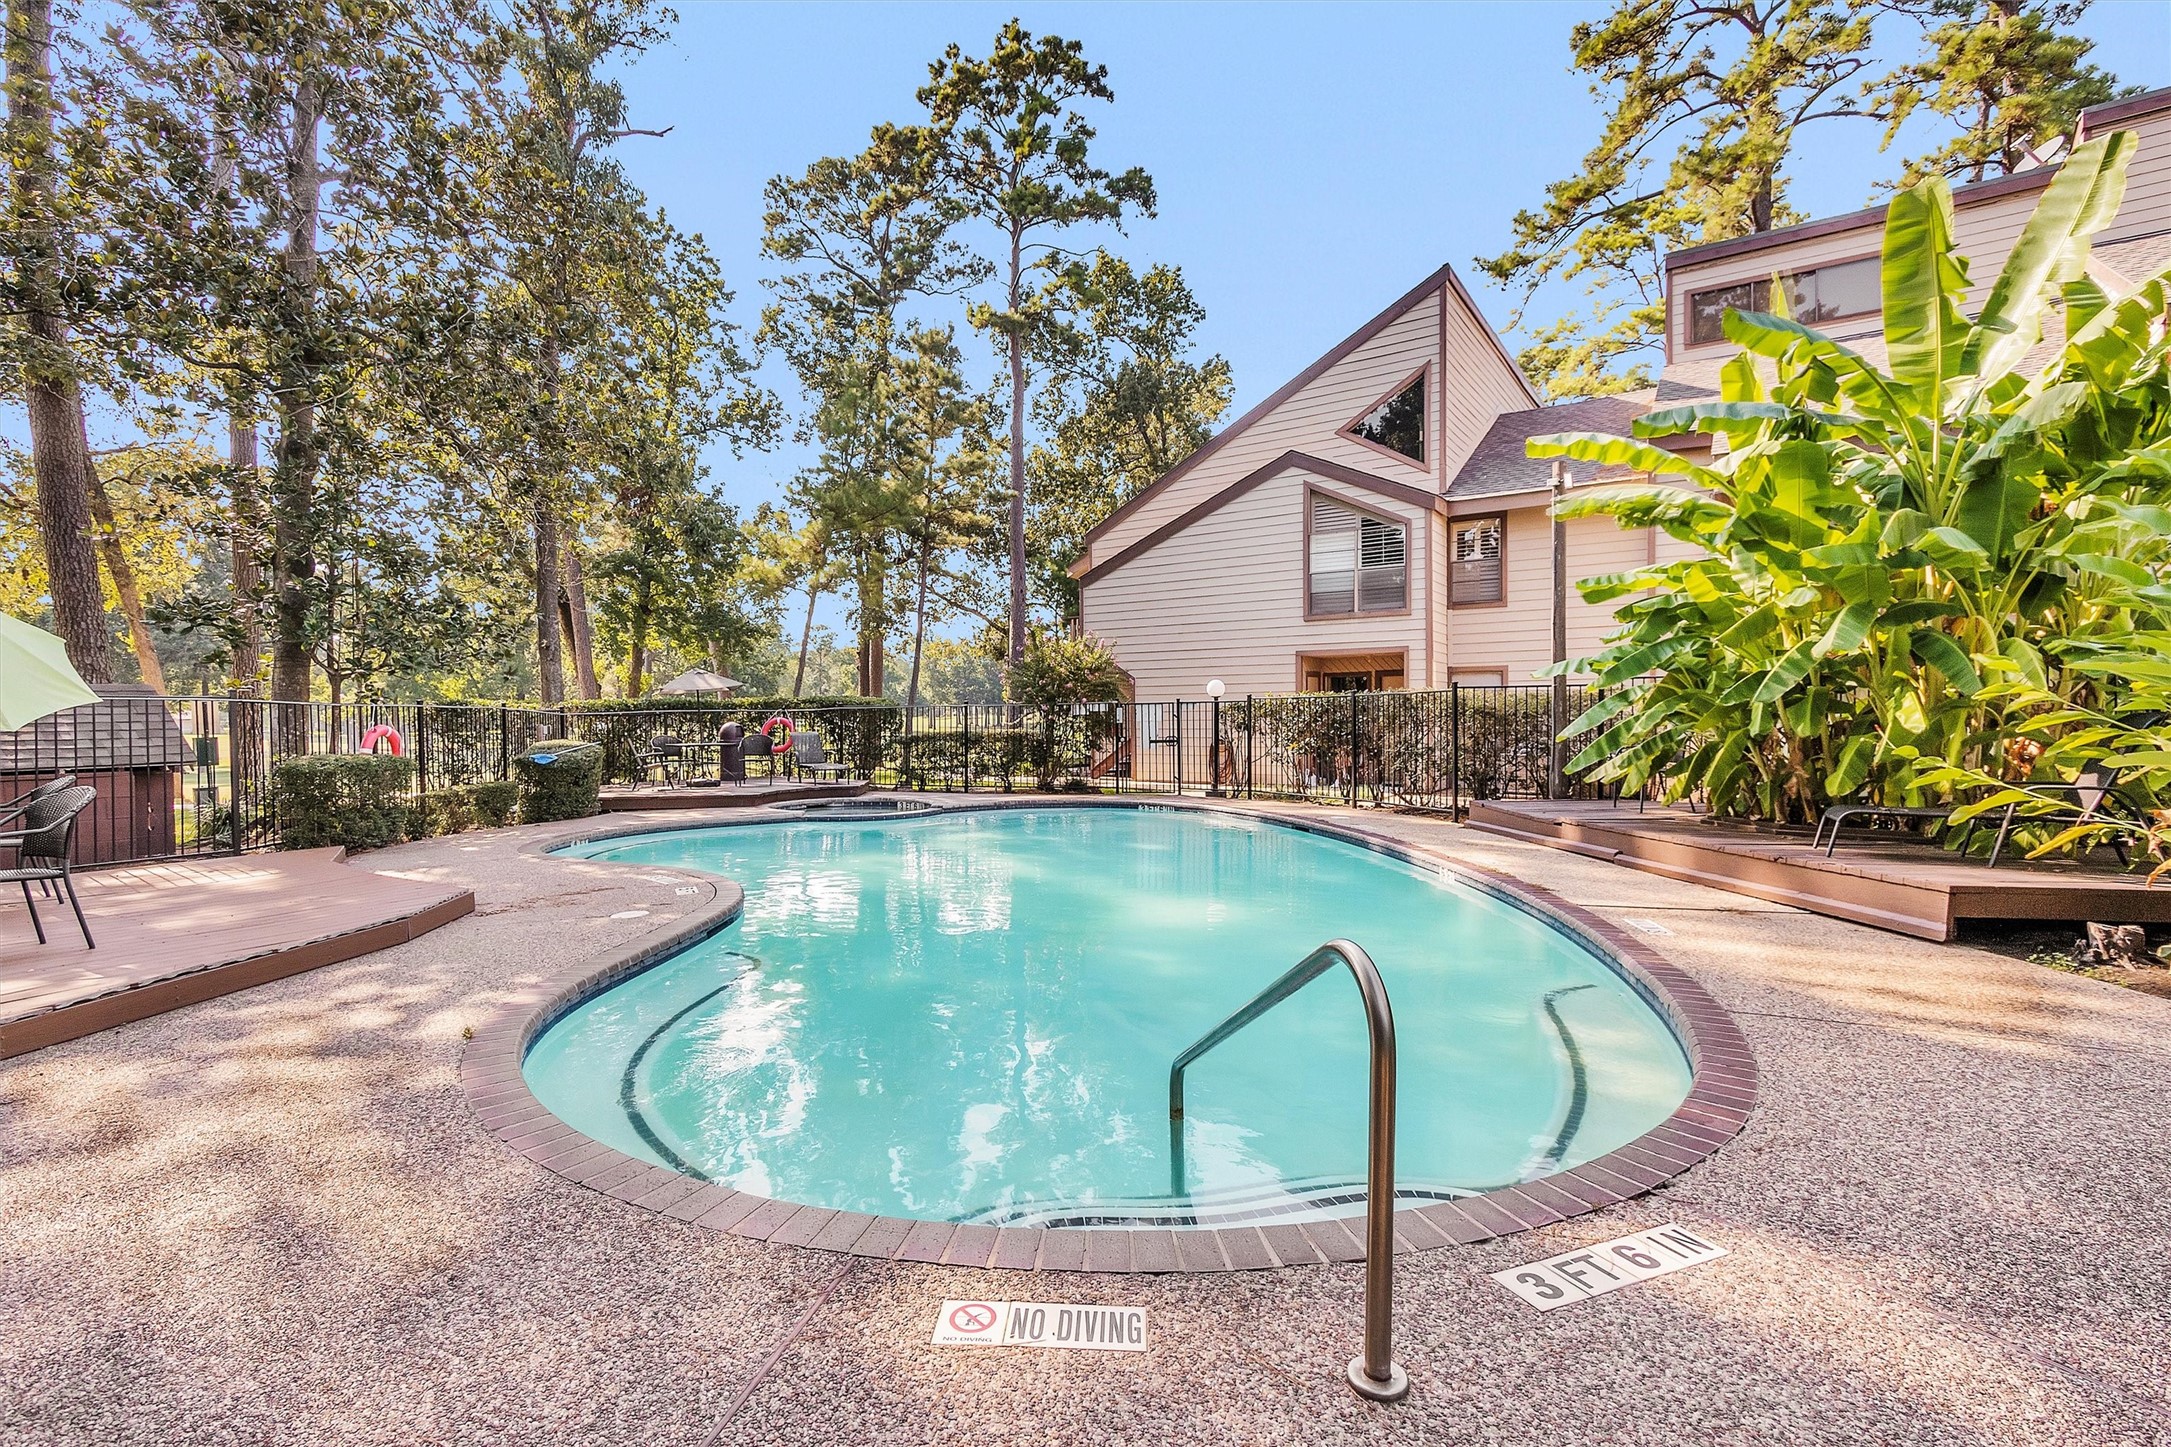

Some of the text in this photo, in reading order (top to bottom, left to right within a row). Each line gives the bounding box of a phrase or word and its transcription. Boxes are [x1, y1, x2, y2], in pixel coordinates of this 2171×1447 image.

[1516, 1228, 1714, 1300] 3 FT 6 IN
[942, 1335, 992, 1344] NO DIVING
[1010, 1307, 1142, 1345] NO DIVING
